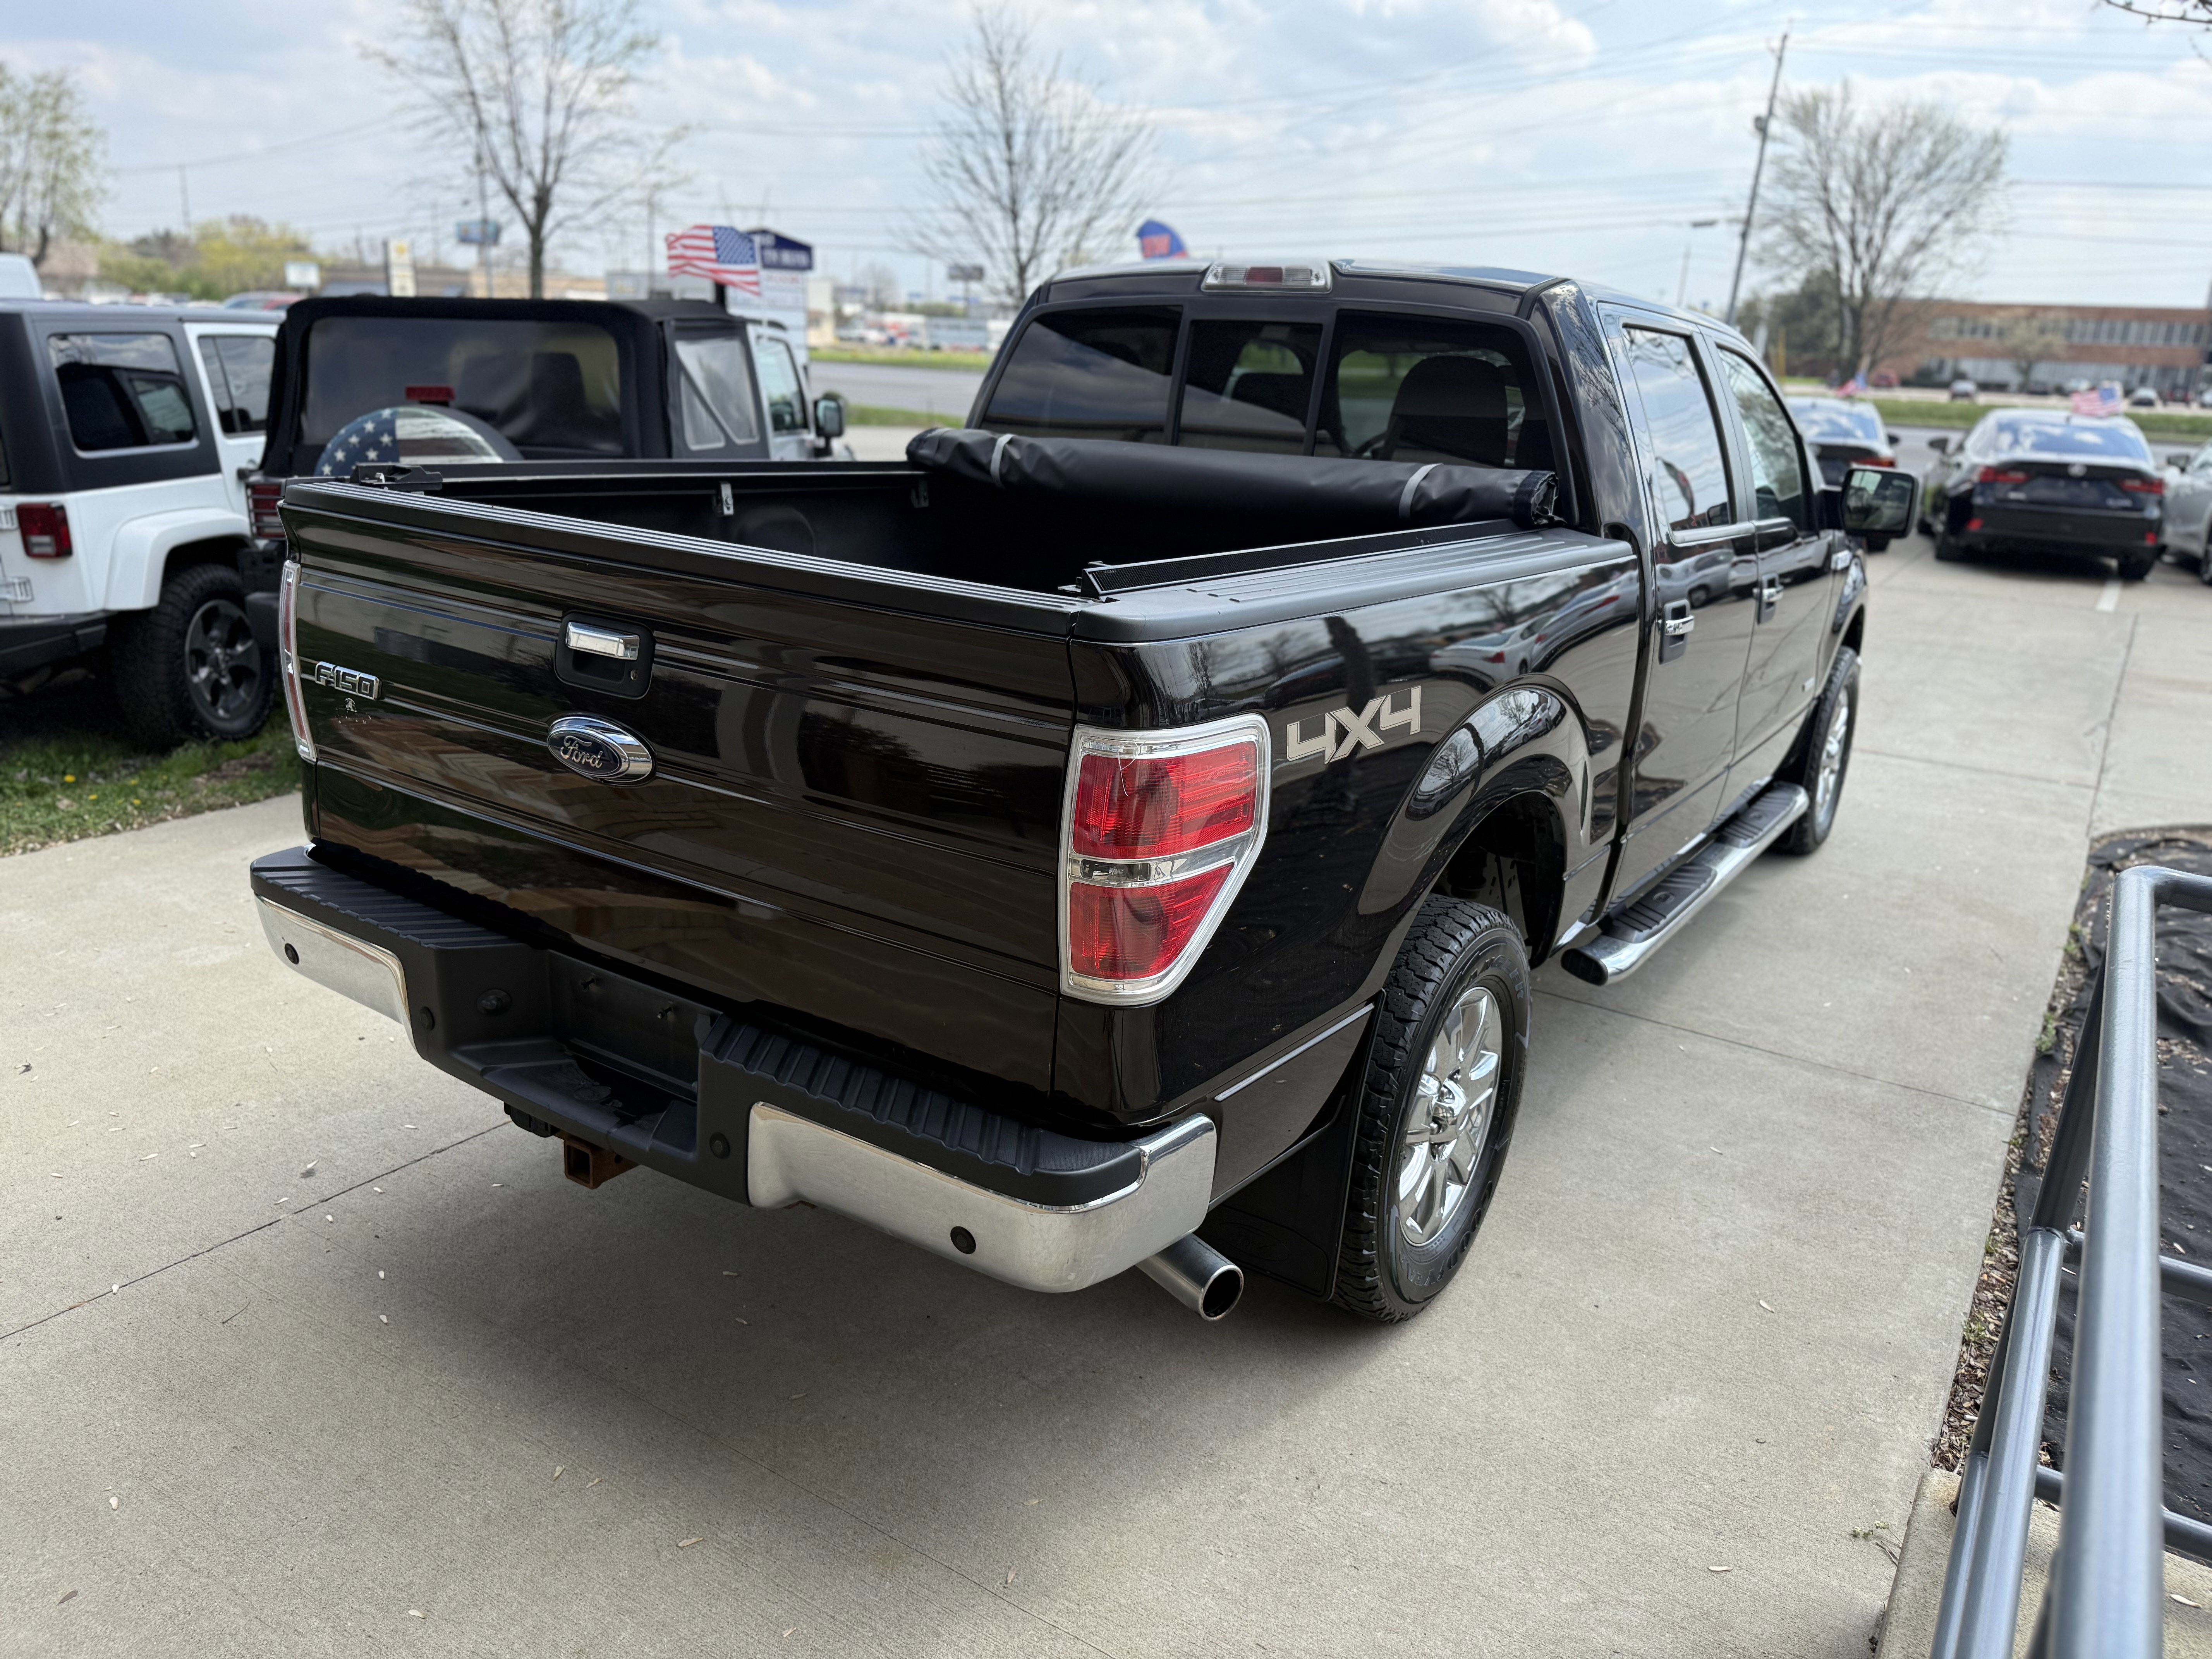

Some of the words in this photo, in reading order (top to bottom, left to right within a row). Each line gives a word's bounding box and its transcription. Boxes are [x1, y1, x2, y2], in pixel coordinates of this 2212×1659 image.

[315, 661, 380, 701] F-150
[560, 735, 603, 769] Ford
[1398, 1180, 1493, 1286] GOODYEAR
